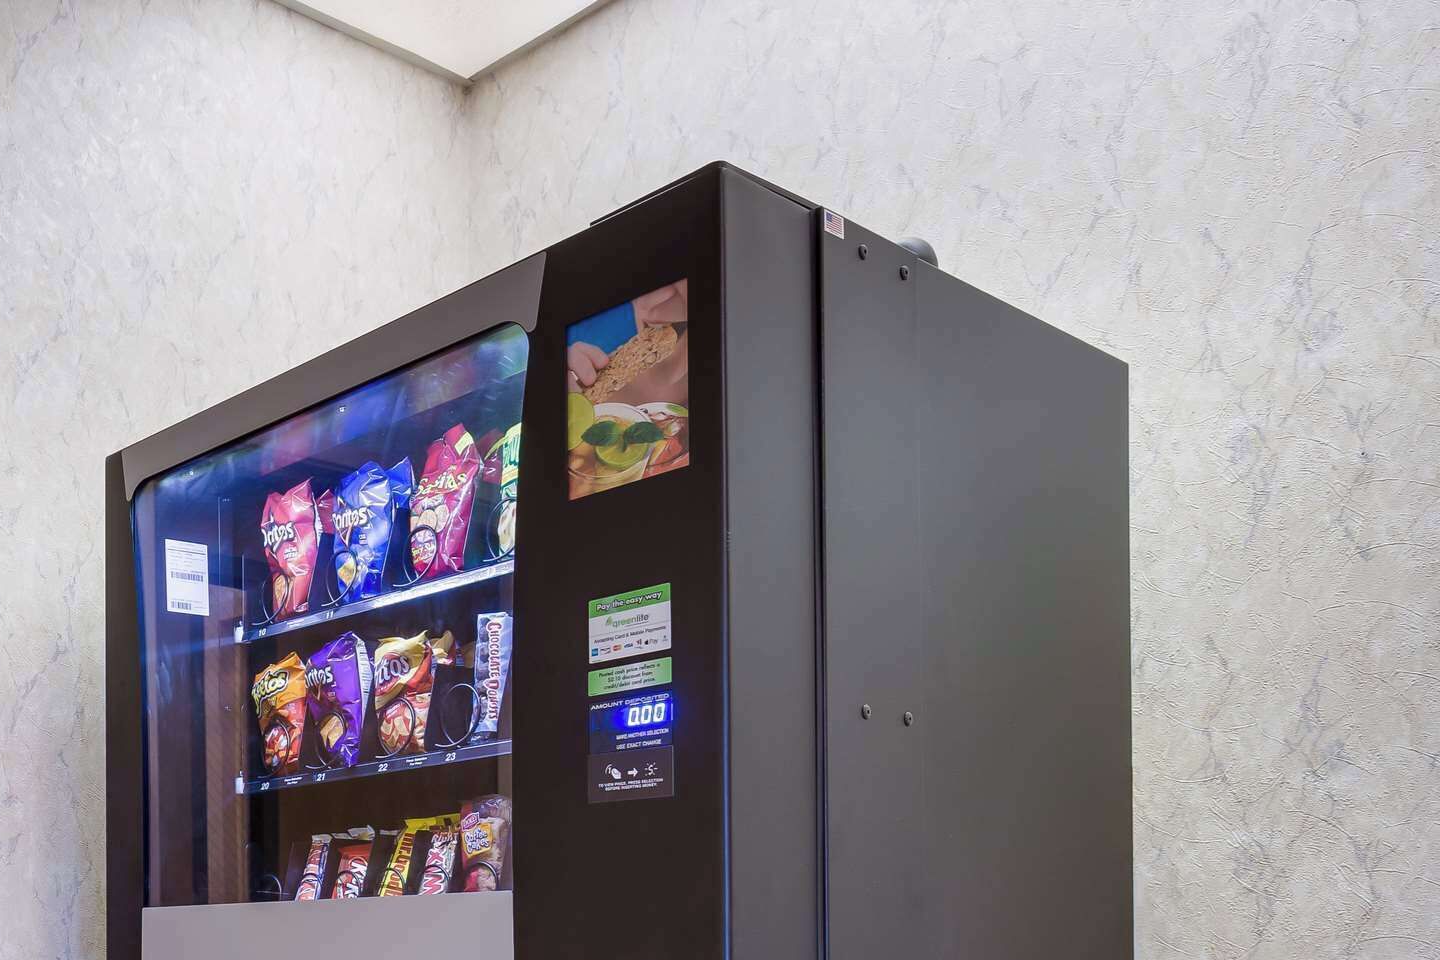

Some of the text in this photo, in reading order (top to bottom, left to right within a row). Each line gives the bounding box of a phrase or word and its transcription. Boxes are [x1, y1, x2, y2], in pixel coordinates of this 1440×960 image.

[596, 591, 662, 611] Pay the easy way
[305, 665, 334, 689] ritos
[375, 655, 410, 686] itos
[590, 693, 670, 711] AMOUNT DEPOSITED
[445, 752, 457, 762] 23
[378, 763, 388, 772] 22
[316, 773, 326, 782] 21
